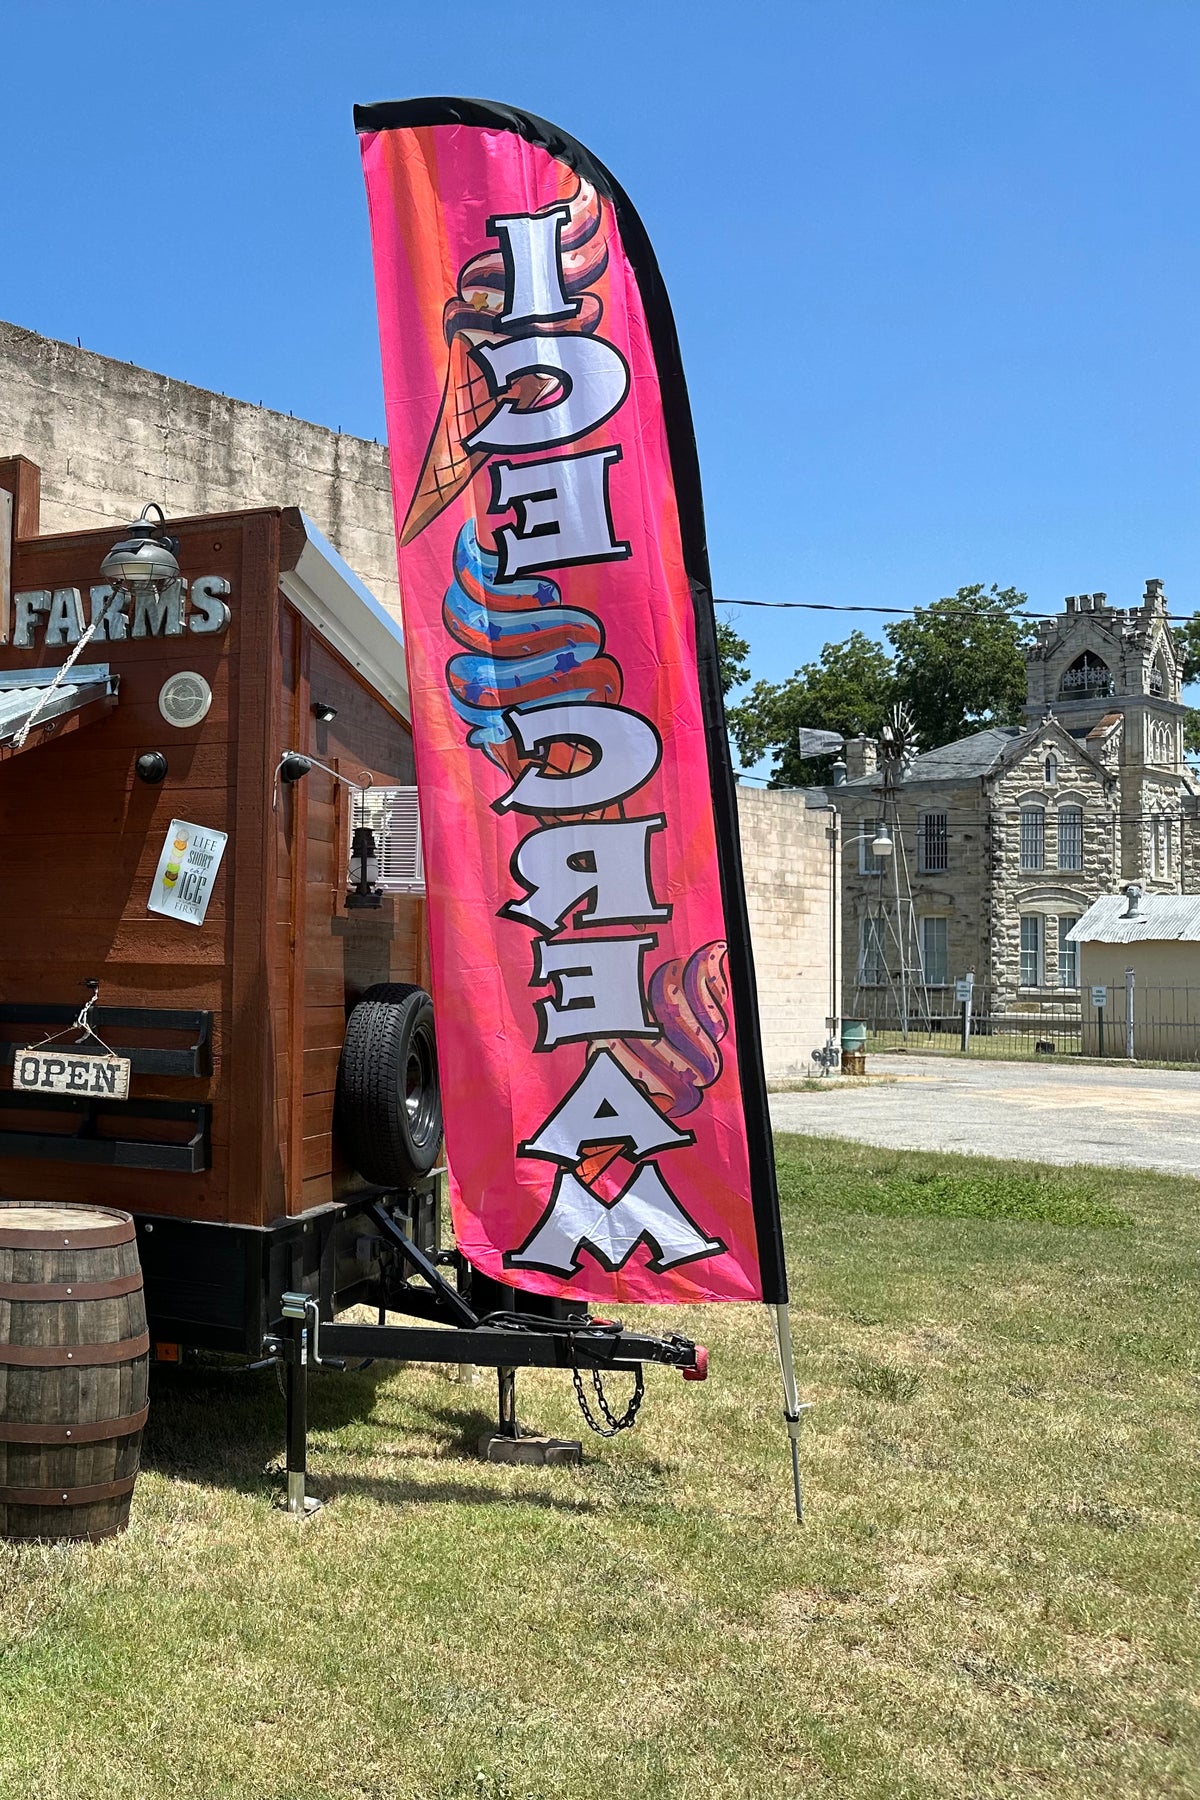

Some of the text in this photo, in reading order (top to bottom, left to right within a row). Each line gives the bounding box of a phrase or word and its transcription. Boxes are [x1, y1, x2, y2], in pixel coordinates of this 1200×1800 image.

[13, 575, 231, 649] FARMS
[193, 835, 218, 852] LIFE
[187, 850, 214, 869] SHORT
[177, 871, 207, 905] ICE
[174, 902, 200, 915] FIRST
[20, 1056, 121, 1093] OPEN
